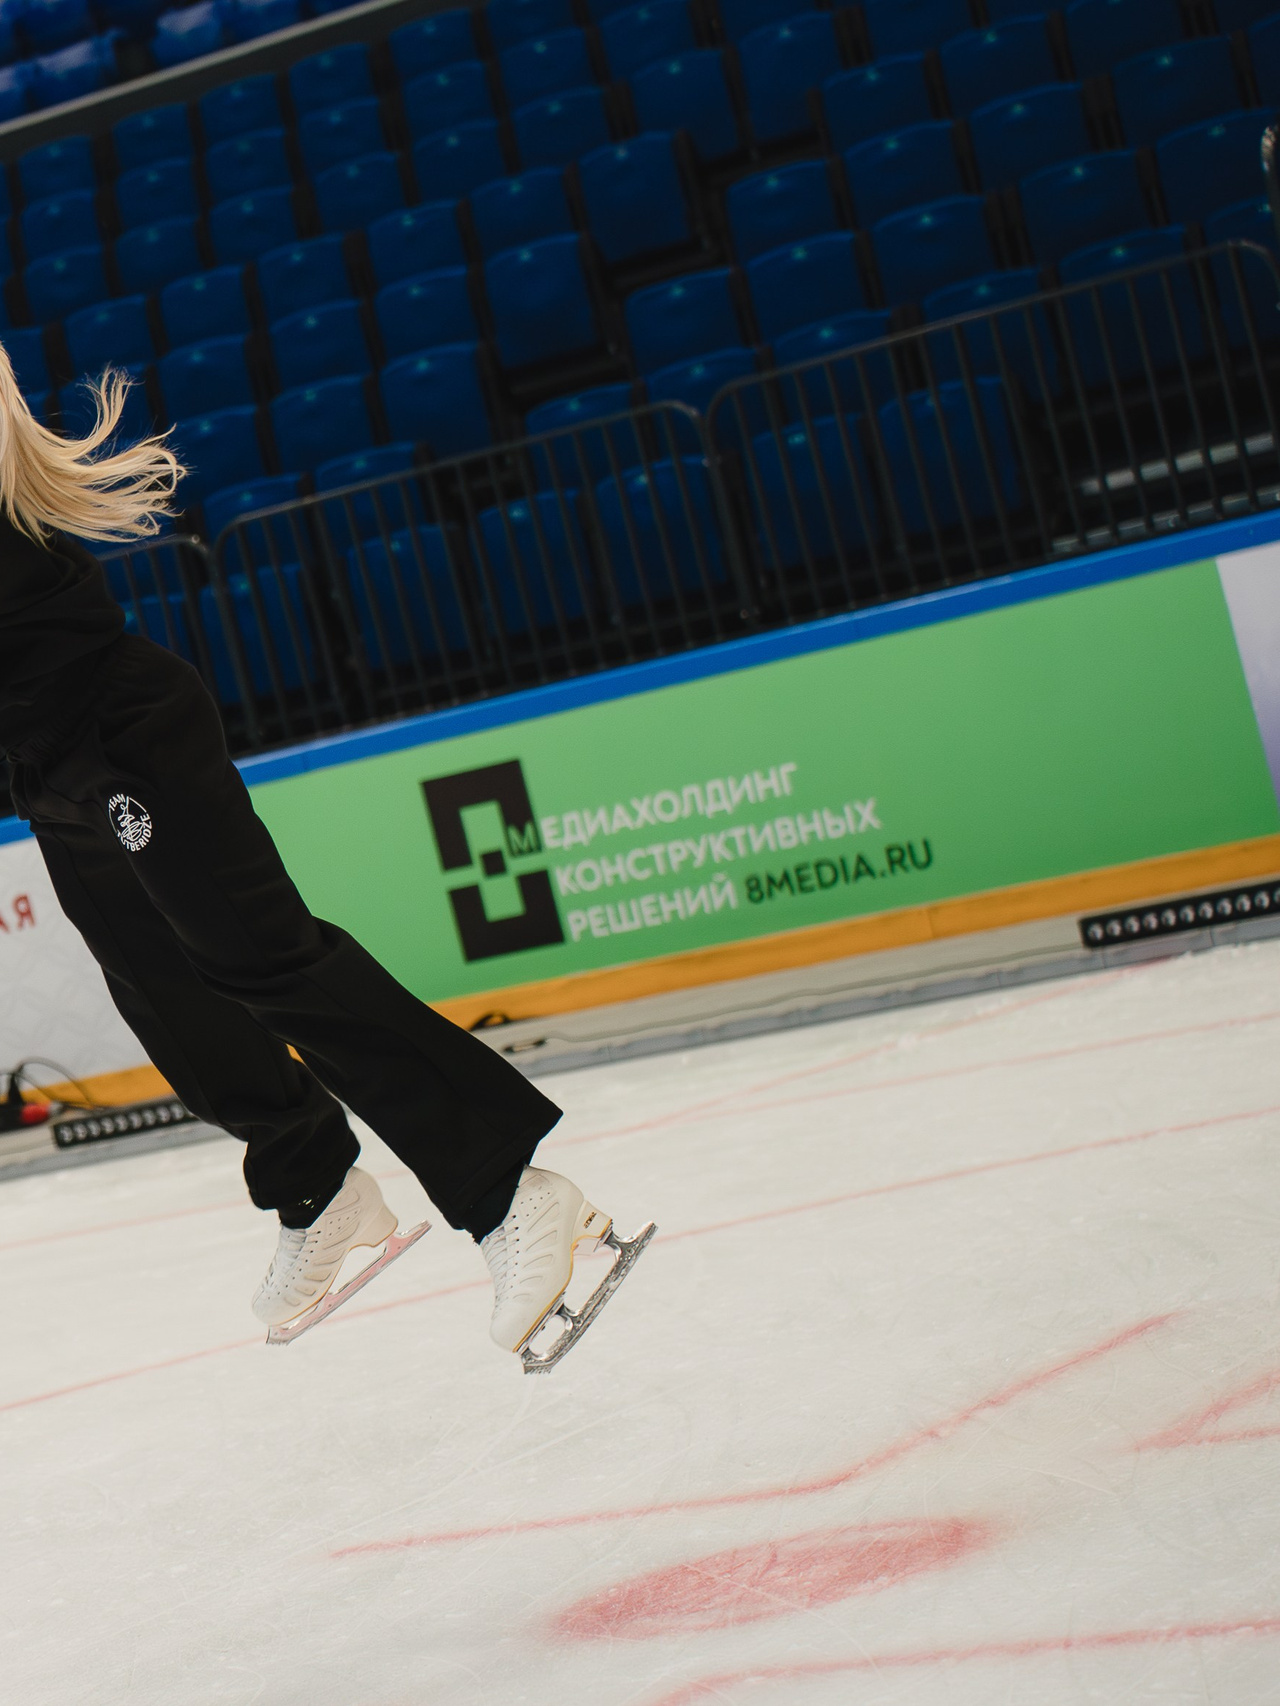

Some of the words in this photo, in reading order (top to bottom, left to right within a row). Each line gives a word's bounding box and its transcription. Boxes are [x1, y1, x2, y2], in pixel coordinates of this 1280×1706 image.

[507, 762, 798, 855] МЕДИАХОЛДИНГ
[554, 799, 882, 896] КОНСТРУКТИВНЫХ
[566, 873, 738, 941] РЕШЕНИЙ
[744, 839, 934, 903] 8MEDIA.RU
